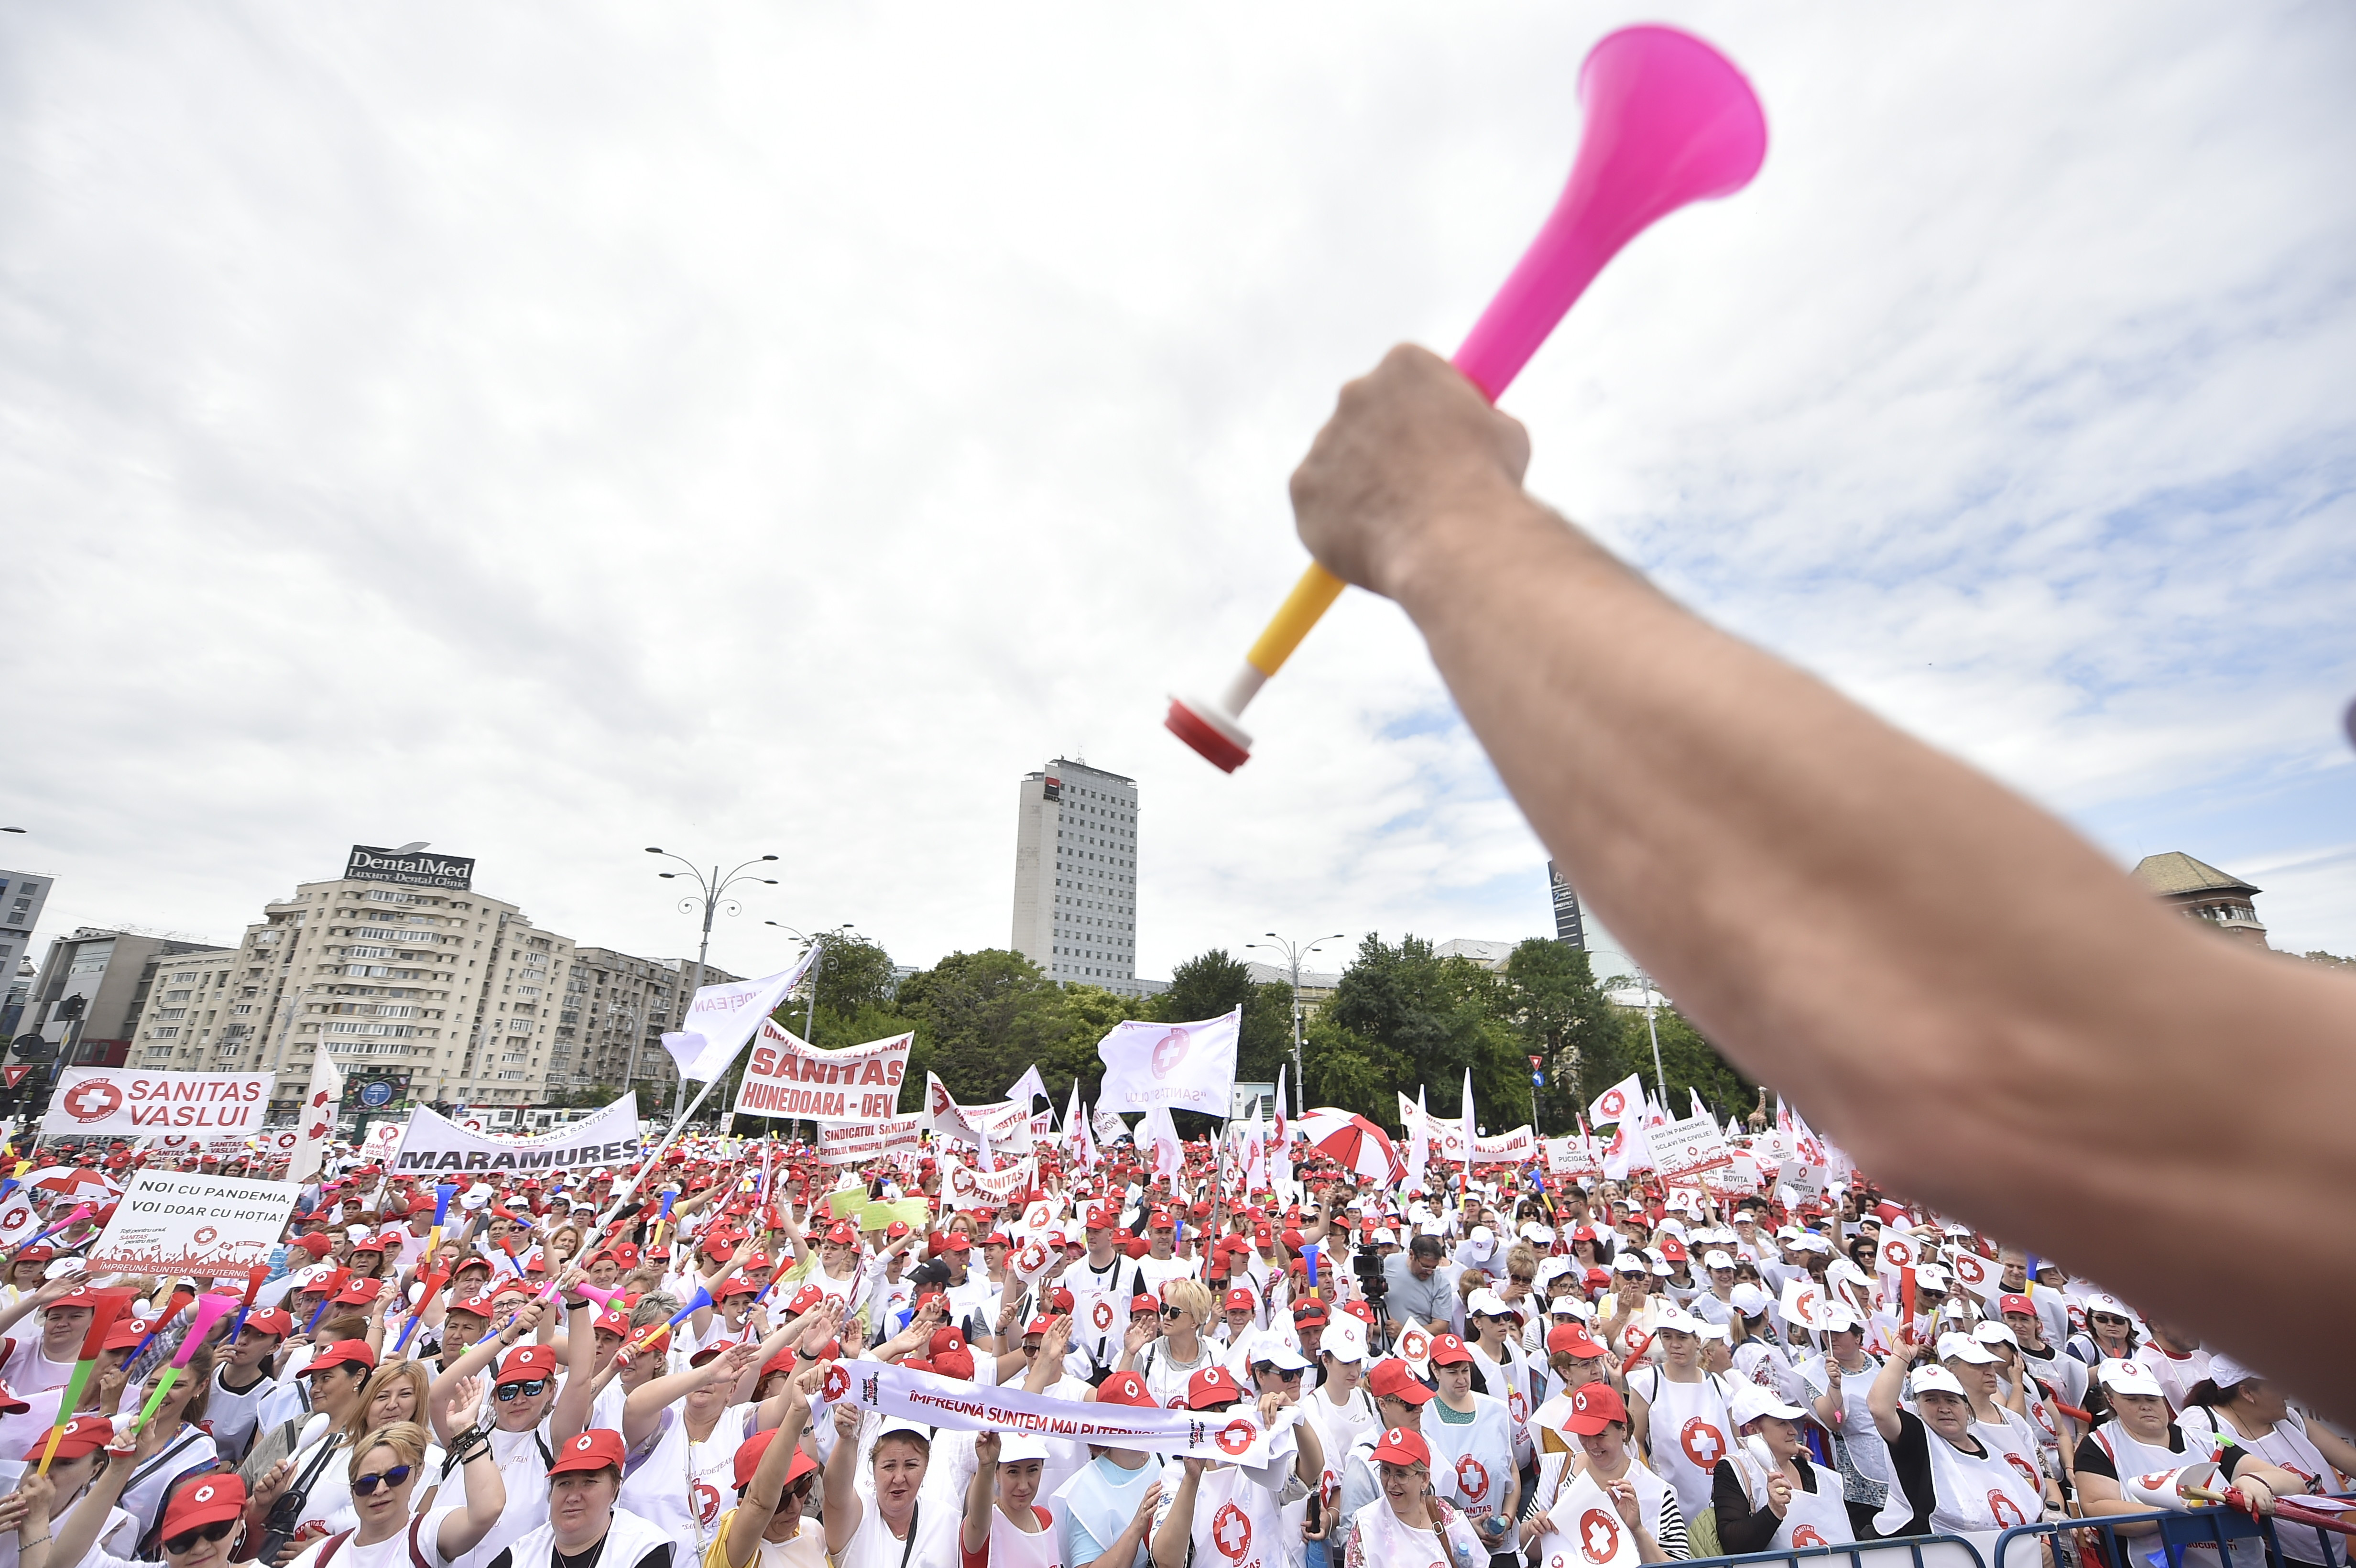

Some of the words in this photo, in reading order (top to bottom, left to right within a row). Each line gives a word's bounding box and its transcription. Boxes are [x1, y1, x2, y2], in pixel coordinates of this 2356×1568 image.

[350, 851, 470, 878] DentalMed
[348, 868, 392, 881] Luxury
[395, 872, 431, 884] Dental
[435, 877, 467, 888] Clinic
[751, 1047, 904, 1086] SANITAS
[76, 1078, 107, 1089] SANITAS
[128, 1080, 261, 1101] SANITAS
[741, 1081, 844, 1116] HUNEDOARA
[130, 1106, 250, 1126] VASLUI
[570, 1108, 615, 1134] SANITAS
[825, 1125, 874, 1141] SINDICATUL
[879, 1120, 917, 1135] SANITAS
[366, 1143, 397, 1152] SANIAS
[398, 1139, 638, 1169] MARAMUREȘ
[820, 1146, 848, 1156] SPITALUL
[849, 1142, 882, 1153] MUNICIPAL
[1461, 1140, 1505, 1153] SNITAS
[1655, 1140, 1678, 1151] SCLAVI
[980, 1168, 1025, 1189] SANITAS
[1724, 1175, 1748, 1183] BOVIȚA
[139, 1181, 175, 1194] NOI
[178, 1186, 201, 1196] CU
[204, 1187, 291, 1204] PANDEMIA,
[132, 1201, 161, 1213] VOI
[164, 1205, 207, 1216] DOAR
[210, 1209, 232, 1218] CU
[234, 1211, 284, 1223] HOȚIA!
[99, 1262, 148, 1272] ÎMPREUNĂ
[150, 1265, 187, 1274] SUNTEM
[909, 1390, 985, 1419] ÎMPREUNĂ
[987, 1406, 1048, 1431] SUNTEM
[1051, 1417, 1079, 1433] MAI
[1215, 1432, 1226, 1449] SANITA
[1464, 1505, 1492, 1515] ANITAS
[1596, 1510, 1618, 1530] SANITAS
[1793, 1524, 1816, 1538] SANITAS
